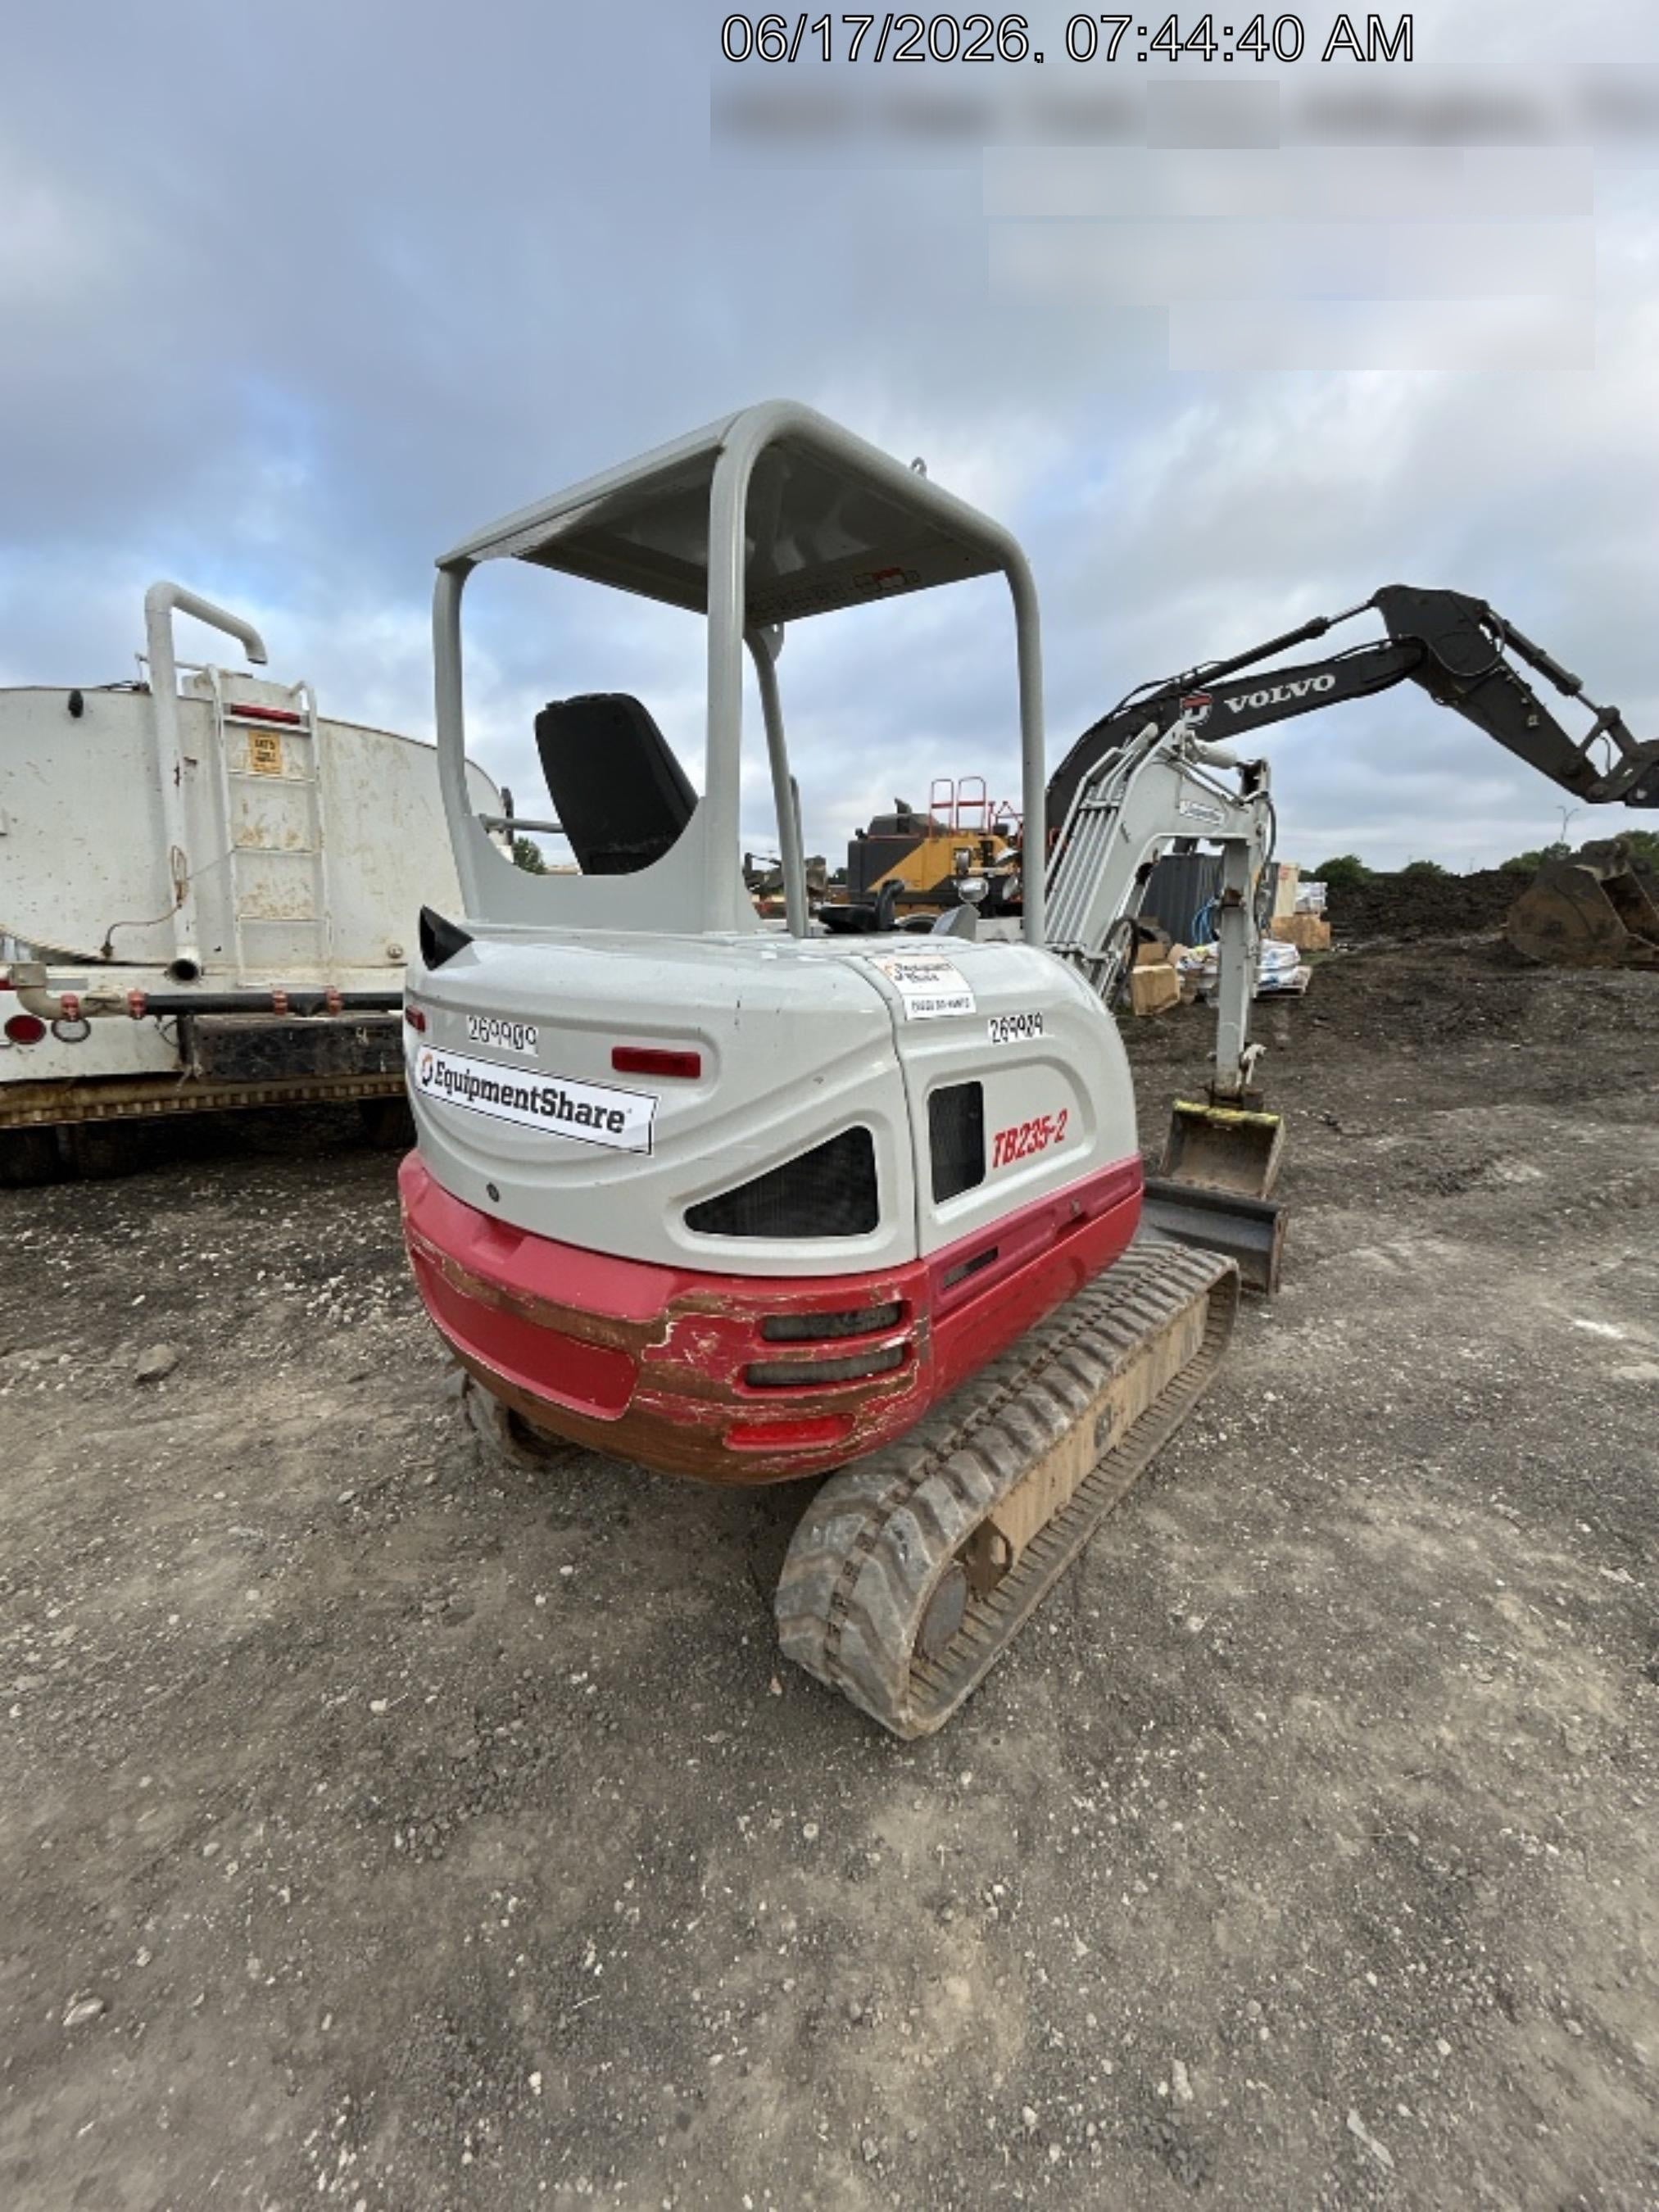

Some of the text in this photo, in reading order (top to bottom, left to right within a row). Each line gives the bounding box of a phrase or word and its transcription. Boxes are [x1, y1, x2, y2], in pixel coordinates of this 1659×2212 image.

[1224, 674, 1336, 714] VOLVO
[435, 1060, 625, 1134] EquipmentShare
[992, 1108, 1068, 1168] TB235-2
